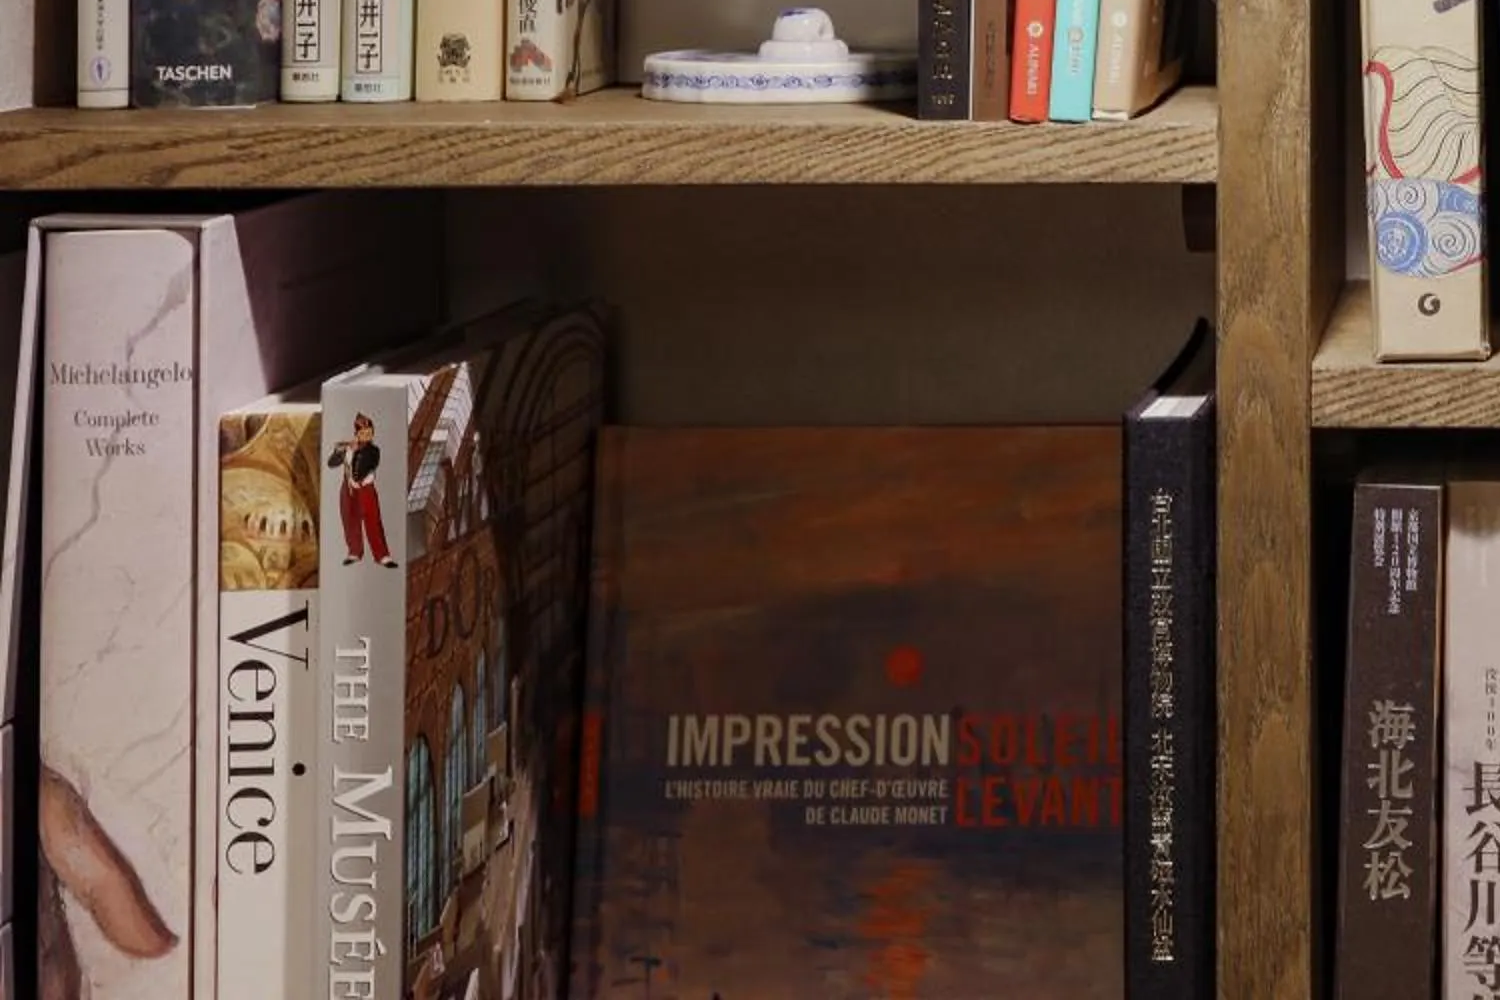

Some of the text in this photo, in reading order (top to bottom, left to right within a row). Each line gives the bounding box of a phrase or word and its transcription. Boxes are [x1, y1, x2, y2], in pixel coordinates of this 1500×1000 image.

[157, 64, 232, 81] TASCHEN
[50, 360, 192, 389] Michelangelo
[73, 409, 159, 435] Complete
[85, 437, 146, 457] Works
[332, 634, 371, 744] THE
[225, 600, 309, 876] Venice
[664, 712, 952, 768] IMPRESSION
[664, 778, 749, 800] L'HISTOIRE
[752, 778, 800, 800] VRAIE
[802, 778, 826, 800] DU
[954, 775, 1121, 827] LEVANT
[1361, 699, 1416, 902] 海北友松
[804, 804, 948, 826] DE CLAUDE MONET
